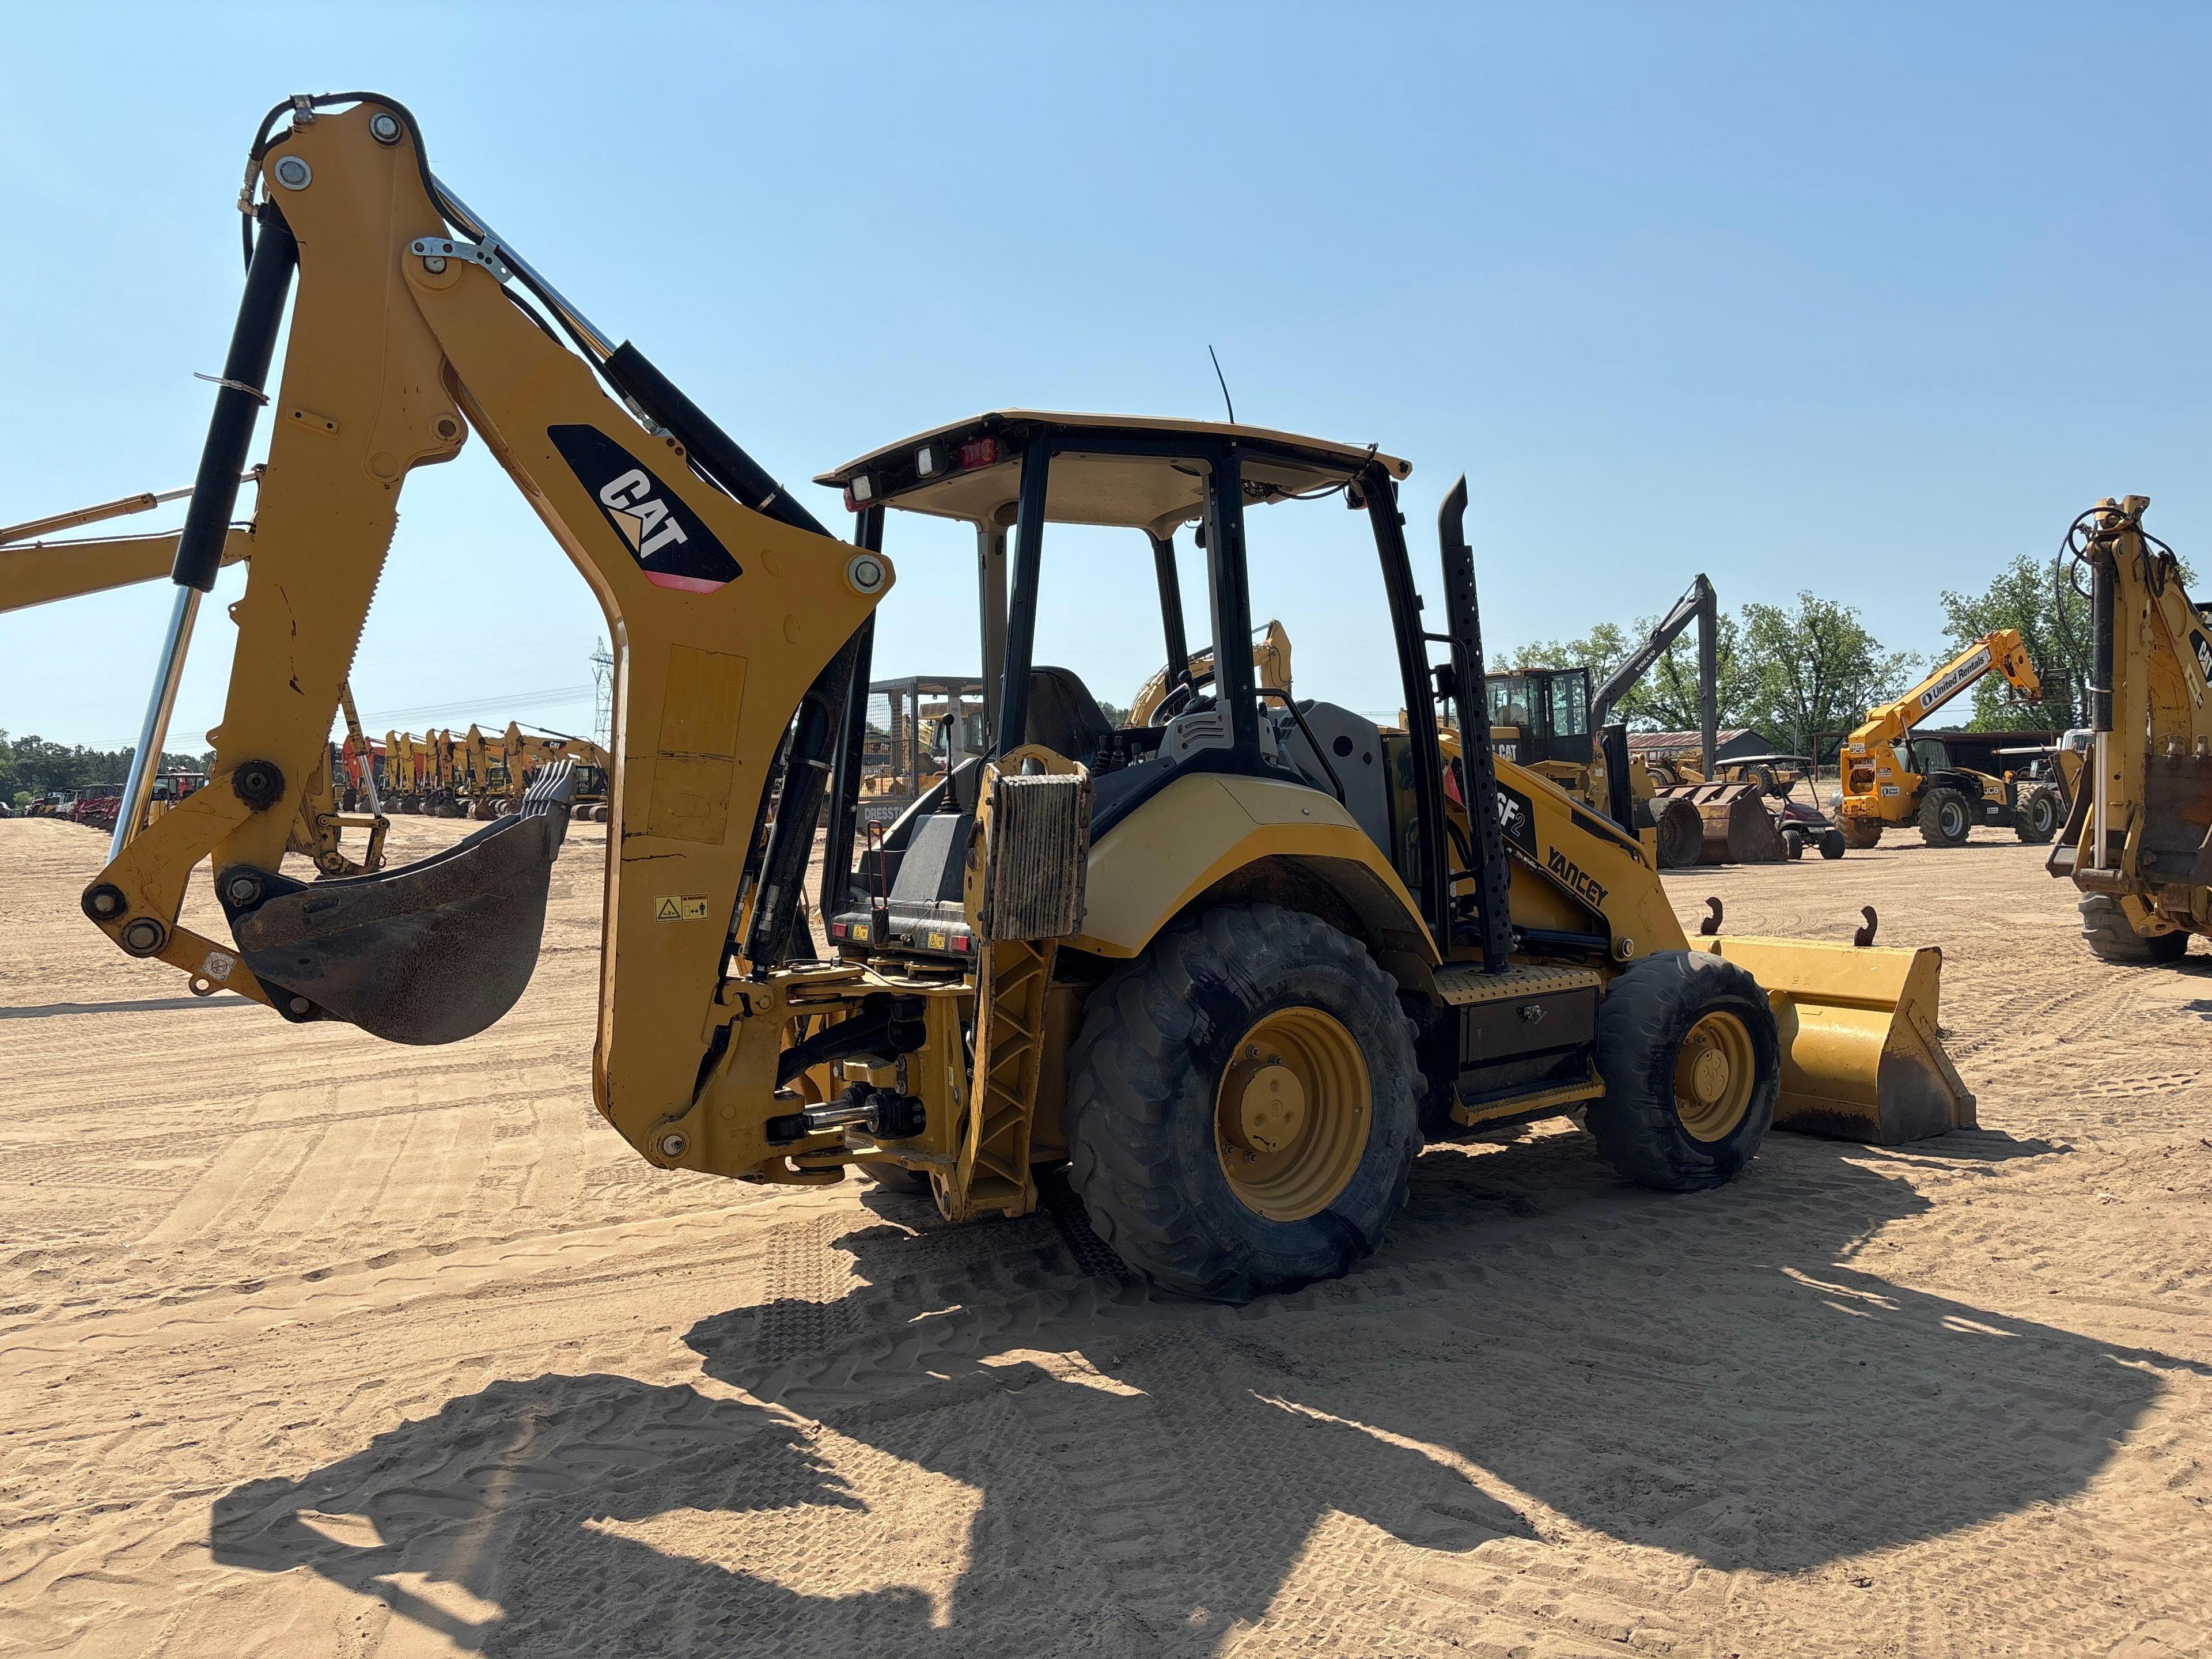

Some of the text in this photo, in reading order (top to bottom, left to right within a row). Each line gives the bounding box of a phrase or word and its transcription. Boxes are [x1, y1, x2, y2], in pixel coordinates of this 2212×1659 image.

[600, 469, 688, 559] CAT
[1634, 649, 1656, 672] VOLVO
[1932, 655, 1985, 699] United Rentals
[550, 741, 561, 750] CAT
[1498, 744, 1517, 762] CAT
[1983, 786, 1999, 795] JCB
[1547, 844, 1609, 908] YANCEY
